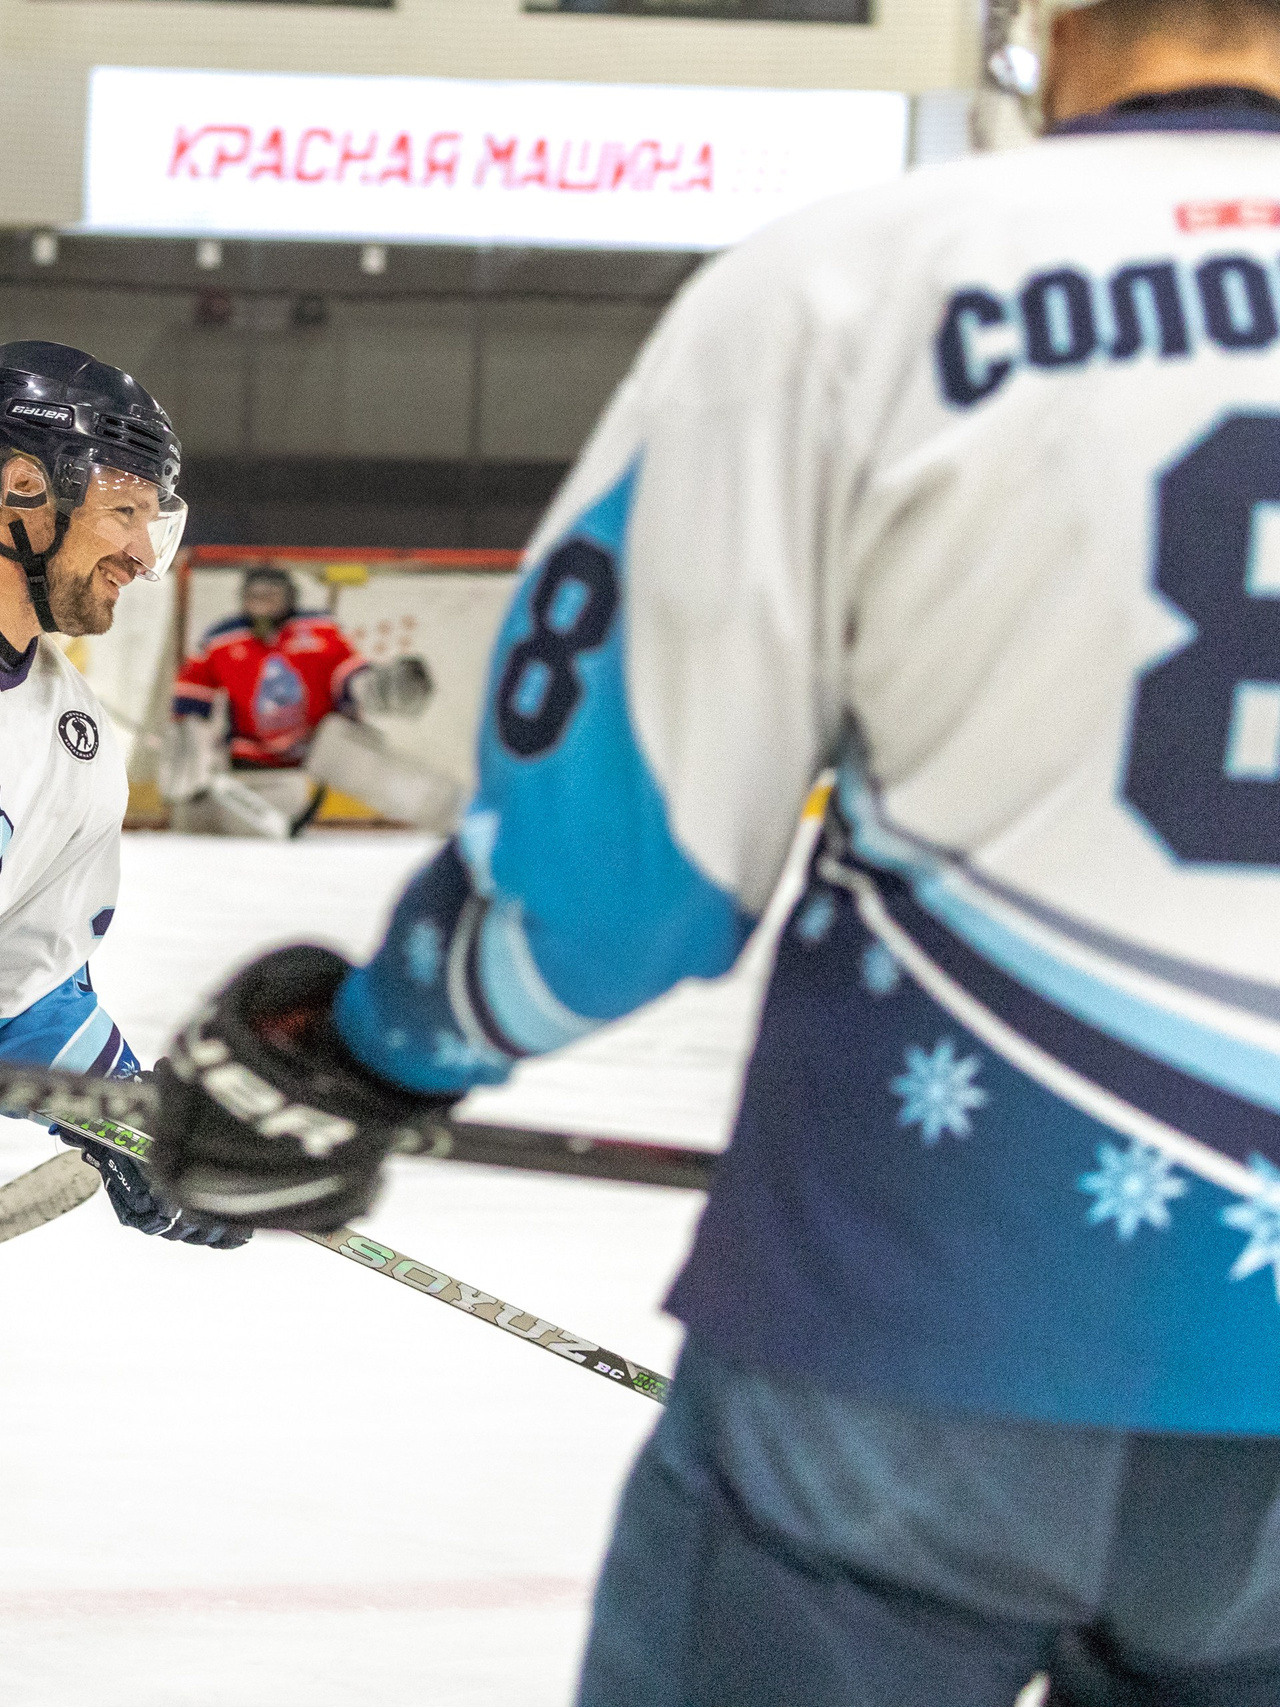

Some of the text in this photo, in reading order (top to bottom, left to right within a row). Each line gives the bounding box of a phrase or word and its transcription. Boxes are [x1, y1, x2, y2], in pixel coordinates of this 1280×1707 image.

[166, 123, 715, 193] КРАСНАЯ МАШИНА
[934, 255, 1280, 410] СОЛО
[11, 404, 70, 422] BAUER
[496, 535, 620, 760] 8
[339, 1236, 602, 1363] SOYUZ
[593, 1361, 625, 1379] BC
